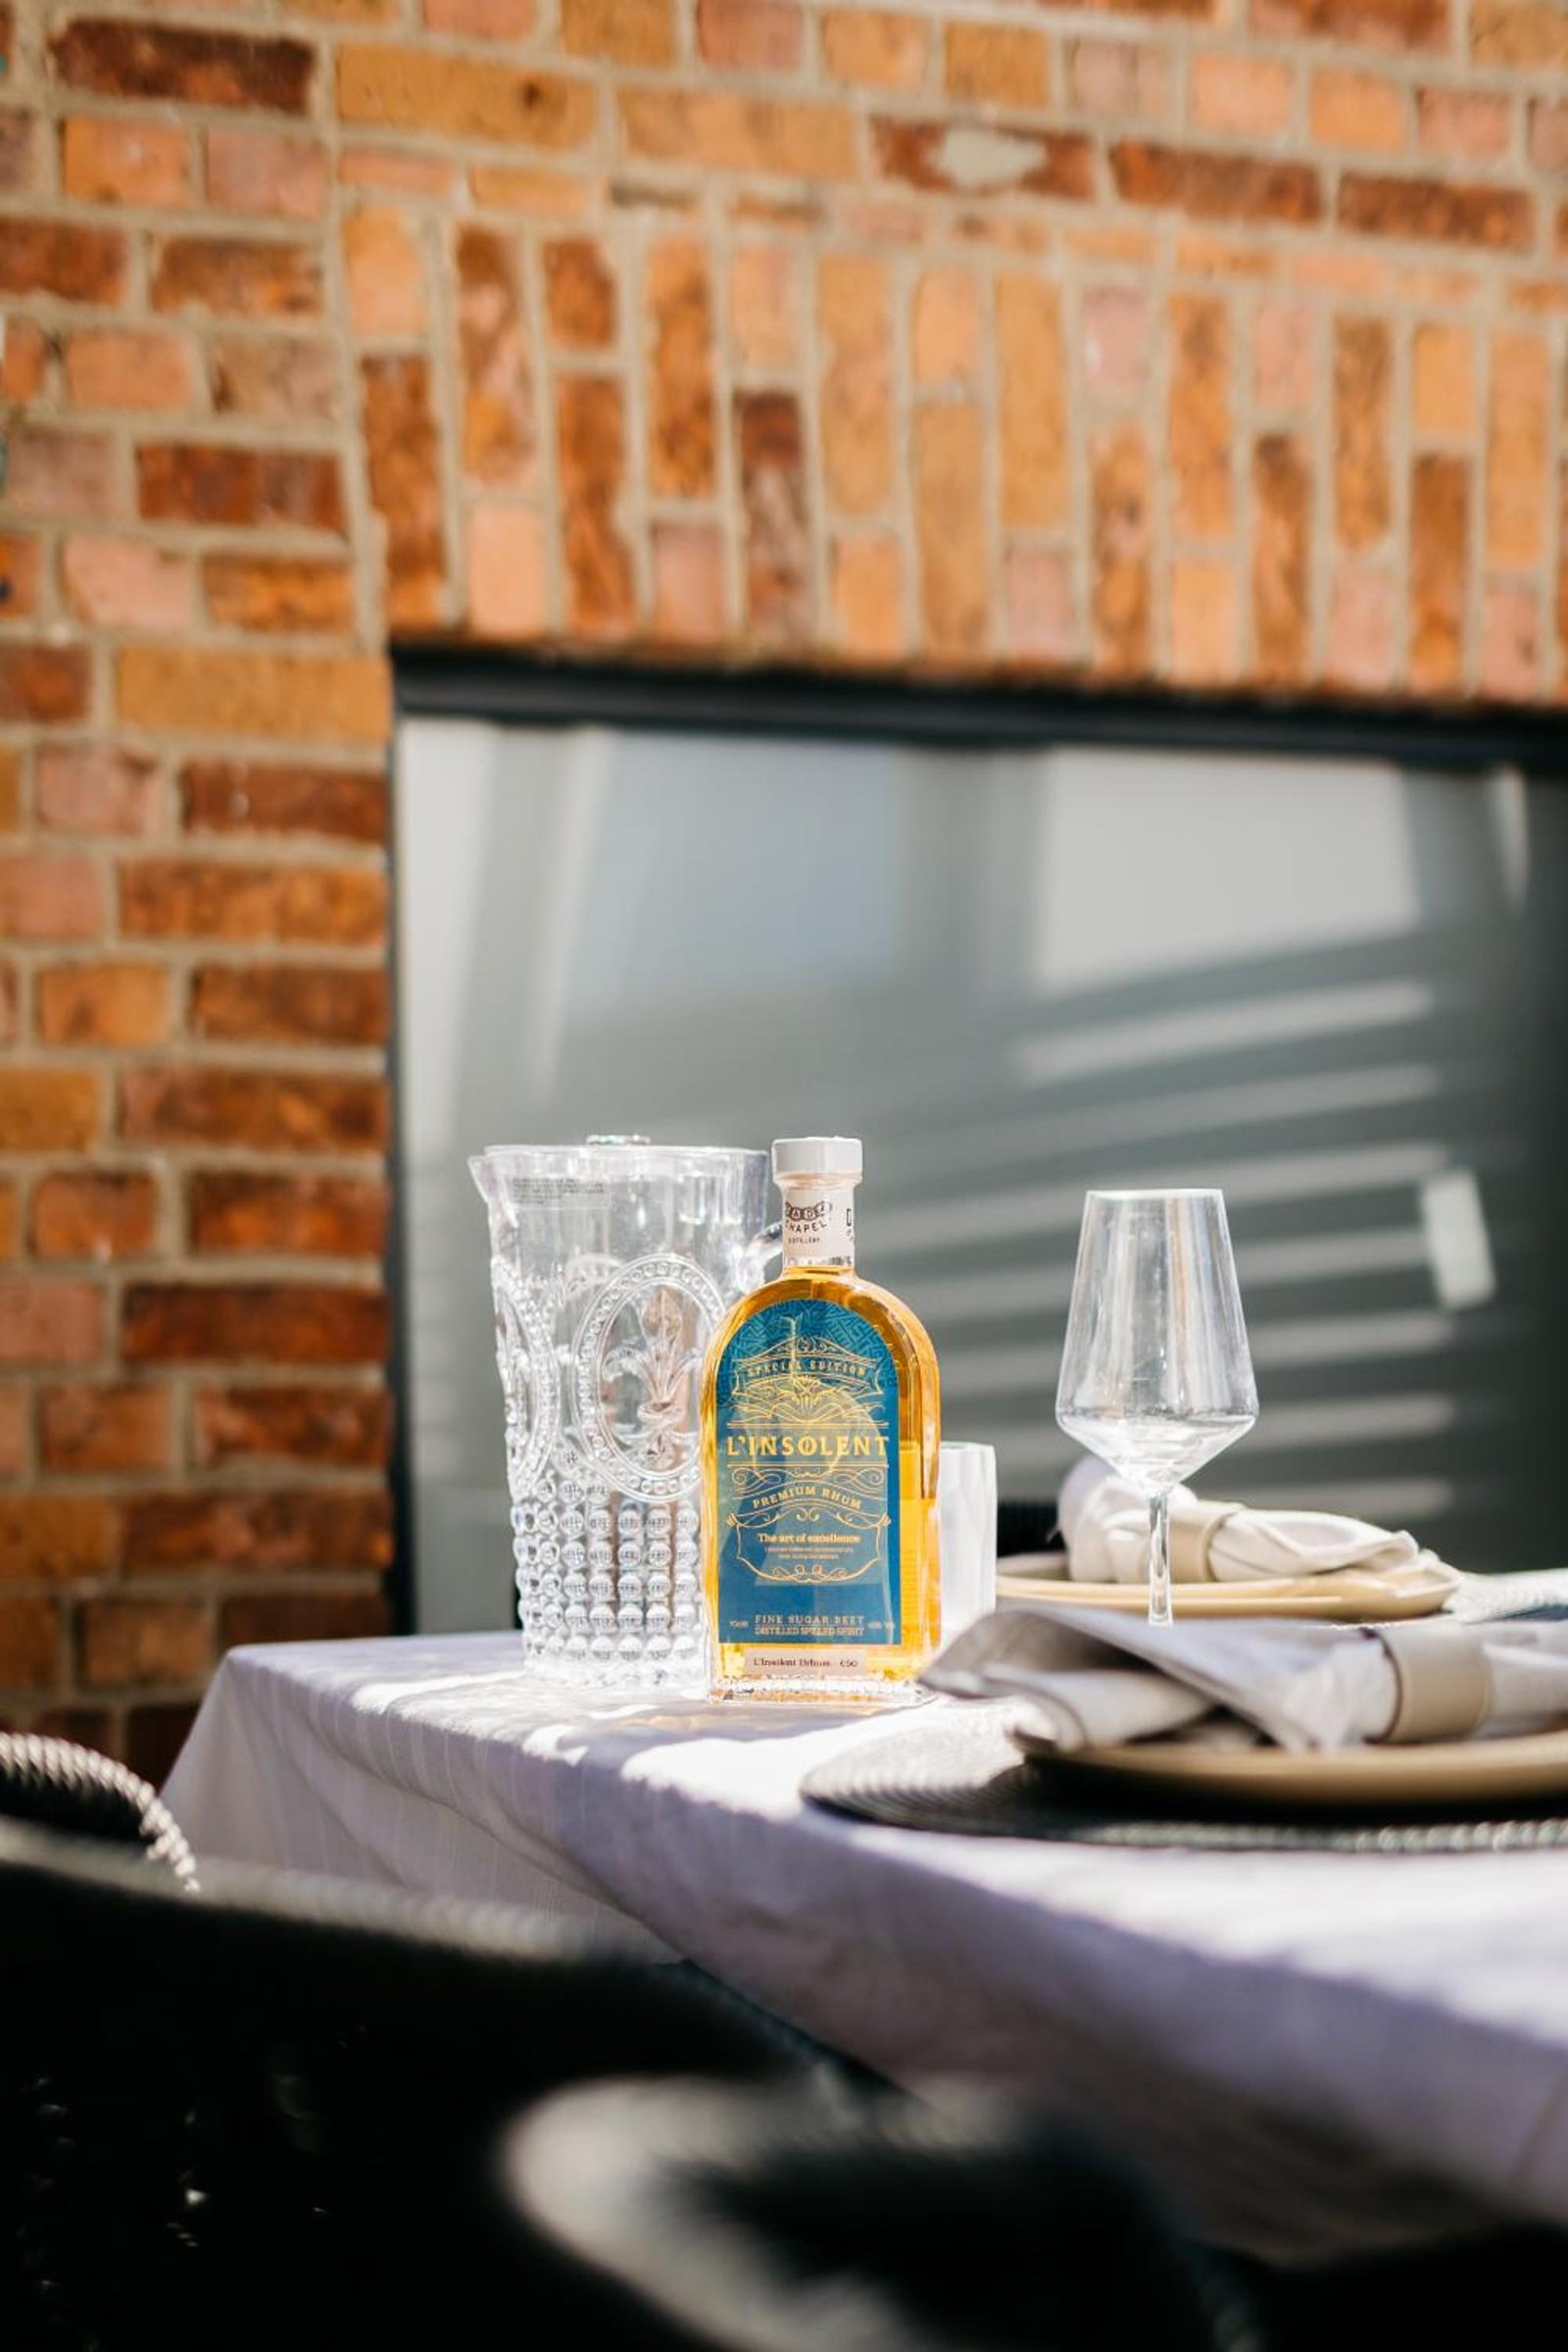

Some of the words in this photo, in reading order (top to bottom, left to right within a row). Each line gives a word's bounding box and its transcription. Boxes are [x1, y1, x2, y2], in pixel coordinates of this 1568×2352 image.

[726, 1432, 890, 1456] L'INSOLENT
[752, 1486, 816, 1509] PREMIUM
[821, 1489, 862, 1509] RHUM
[758, 1533, 777, 1544] The
[778, 1534, 795, 1544] art
[796, 1533, 807, 1544] of
[807, 1533, 860, 1544] excellence
[755, 1614, 783, 1624] FINE
[788, 1615, 830, 1624] SUGAR
[834, 1615, 865, 1625] BEET
